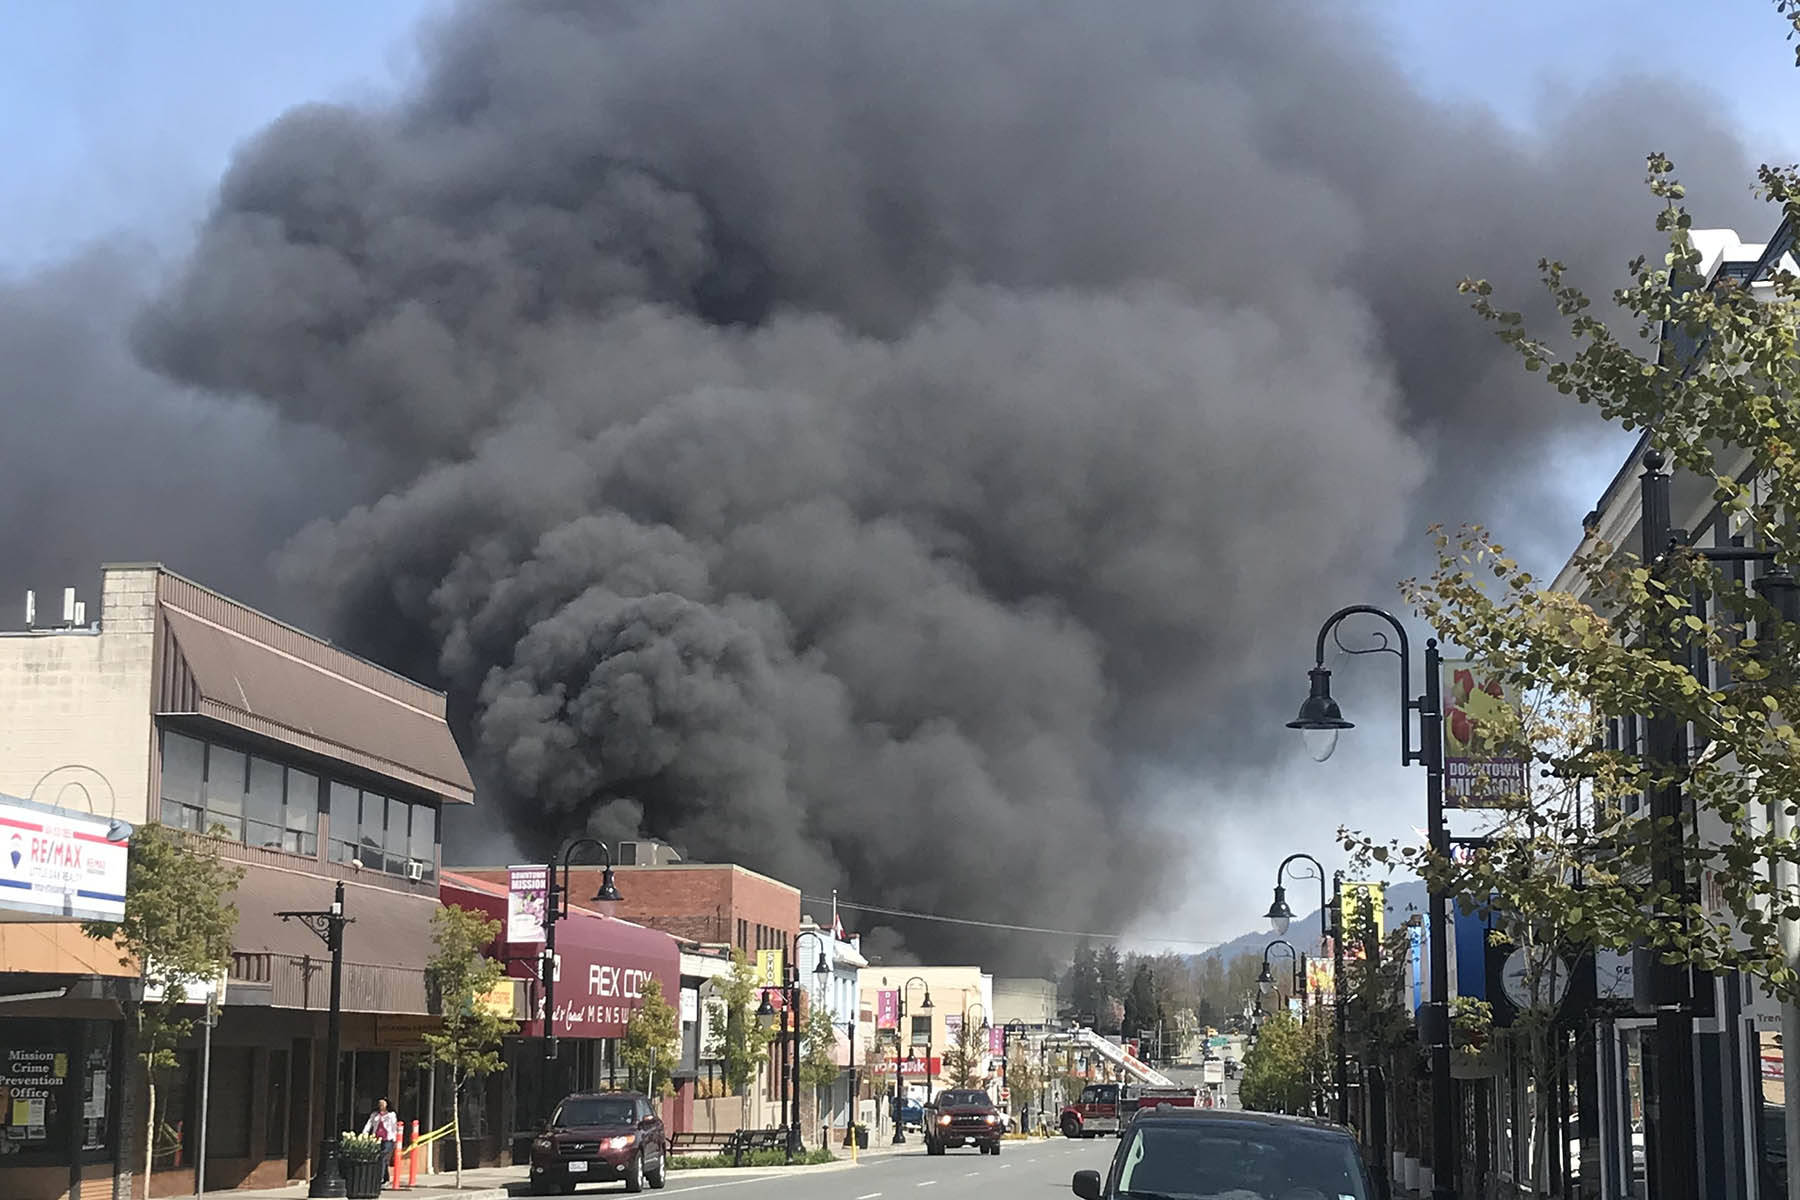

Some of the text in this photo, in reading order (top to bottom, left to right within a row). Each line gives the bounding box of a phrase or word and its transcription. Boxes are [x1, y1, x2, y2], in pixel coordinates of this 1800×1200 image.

[31, 837, 82, 869] RE/MAX
[511, 880, 546, 890] MISSION
[588, 964, 621, 998] REX
[8, 1050, 54, 1061] Mission
[12, 1063, 50, 1073] Crime
[0, 1075, 64, 1086] Prevention
[10, 1087, 49, 1098] Office
